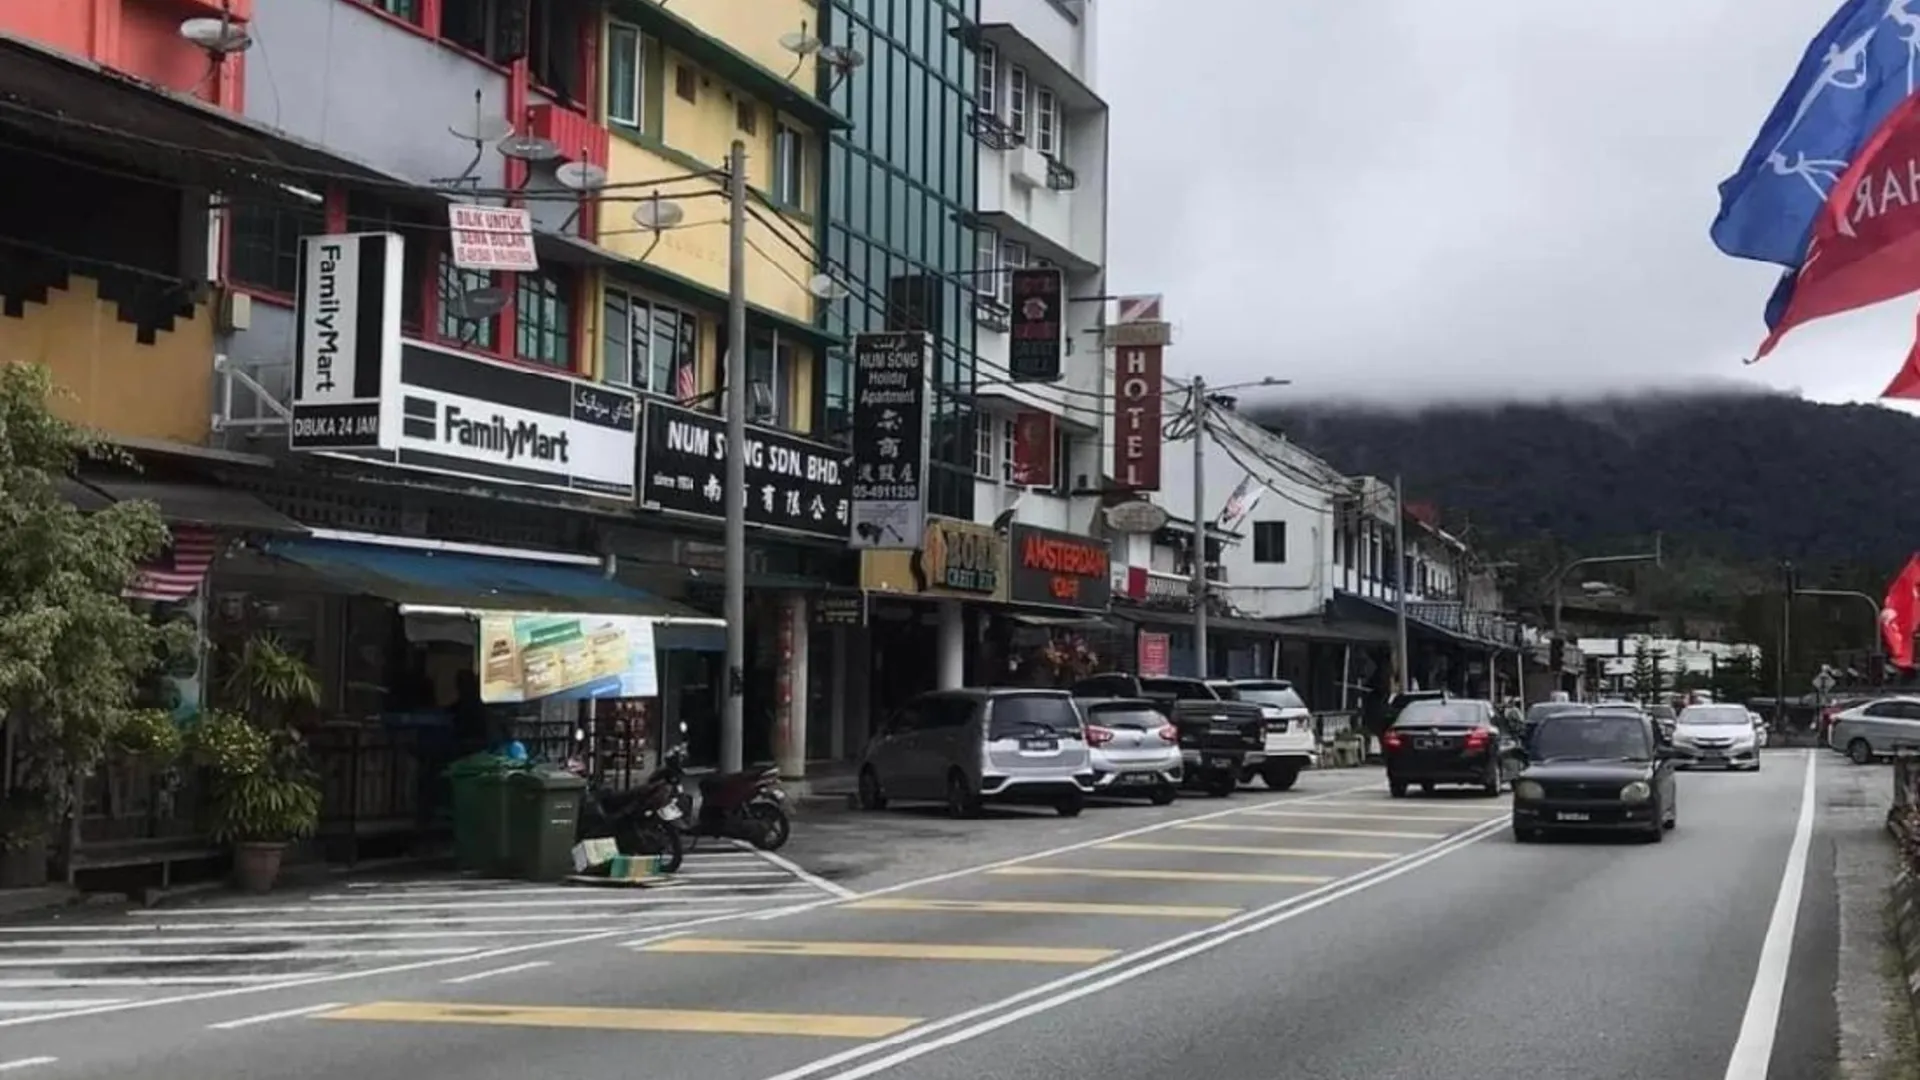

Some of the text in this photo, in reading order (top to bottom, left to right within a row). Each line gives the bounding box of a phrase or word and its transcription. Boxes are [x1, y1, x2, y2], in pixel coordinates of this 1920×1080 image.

[456, 209, 524, 231] BILIK UNTUK
[315, 244, 342, 392] FamilyMart
[860, 351, 919, 369] NUM SONG
[861, 388, 915, 408] Apartment
[1124, 351, 1148, 486] HOTEL
[294, 415, 378, 437] DIBUKA 24 JAM
[445, 404, 569, 463] FamilyMart
[667, 420, 710, 457] NUM
[713, 432, 763, 468] SNG
[807, 454, 842, 486] BHD.
[703, 473, 849, 526] 南有限公司
[1023, 535, 1109, 578] AMSTERDAM
